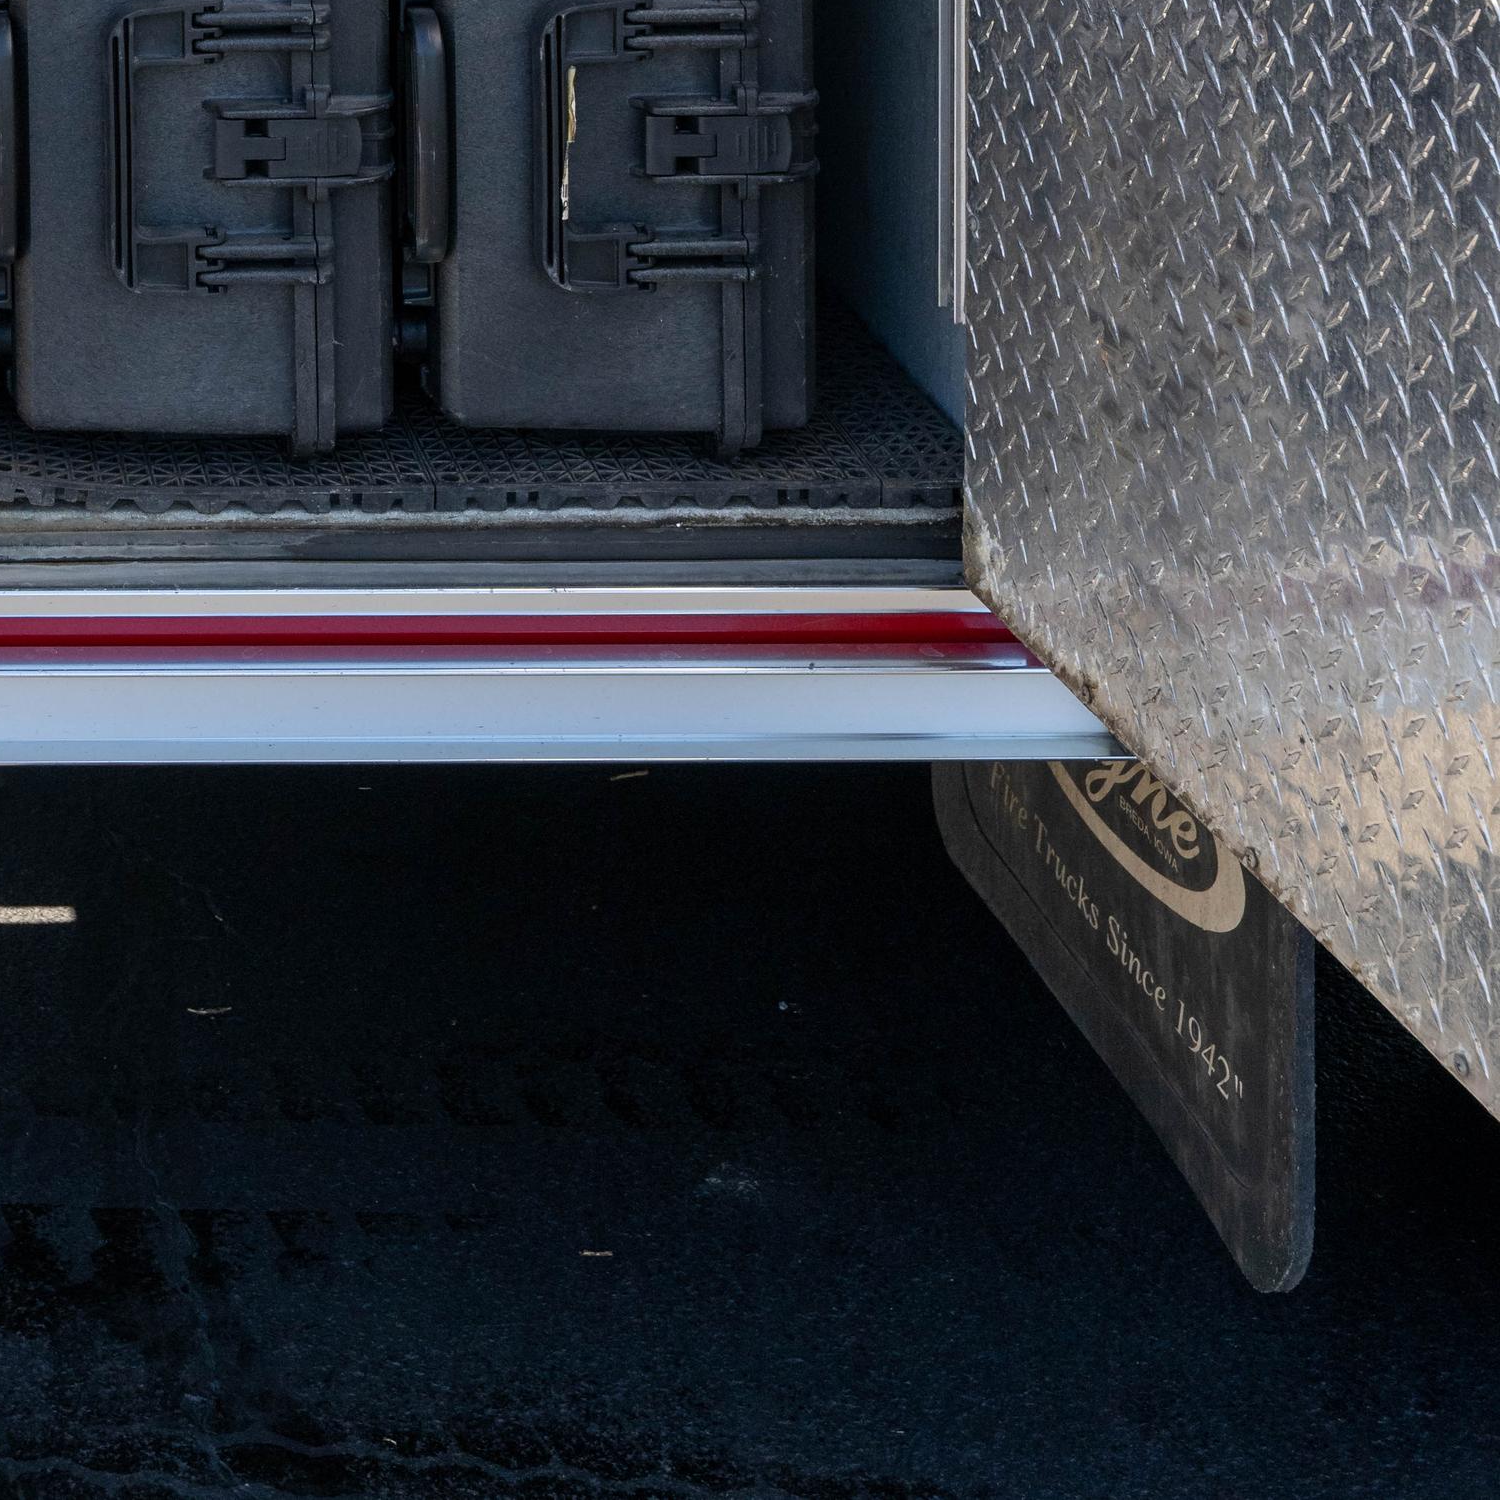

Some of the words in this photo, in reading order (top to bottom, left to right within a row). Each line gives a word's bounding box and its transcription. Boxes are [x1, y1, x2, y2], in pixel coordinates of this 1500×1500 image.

[990, 761, 1029, 830] Fire
[1034, 813, 1099, 930] Trucks
[1106, 914, 1166, 1012] Since
[1175, 999, 1244, 1101] 1942"
[1118, 795, 1151, 842] BREDA,
[1154, 837, 1179, 873] IOWA
